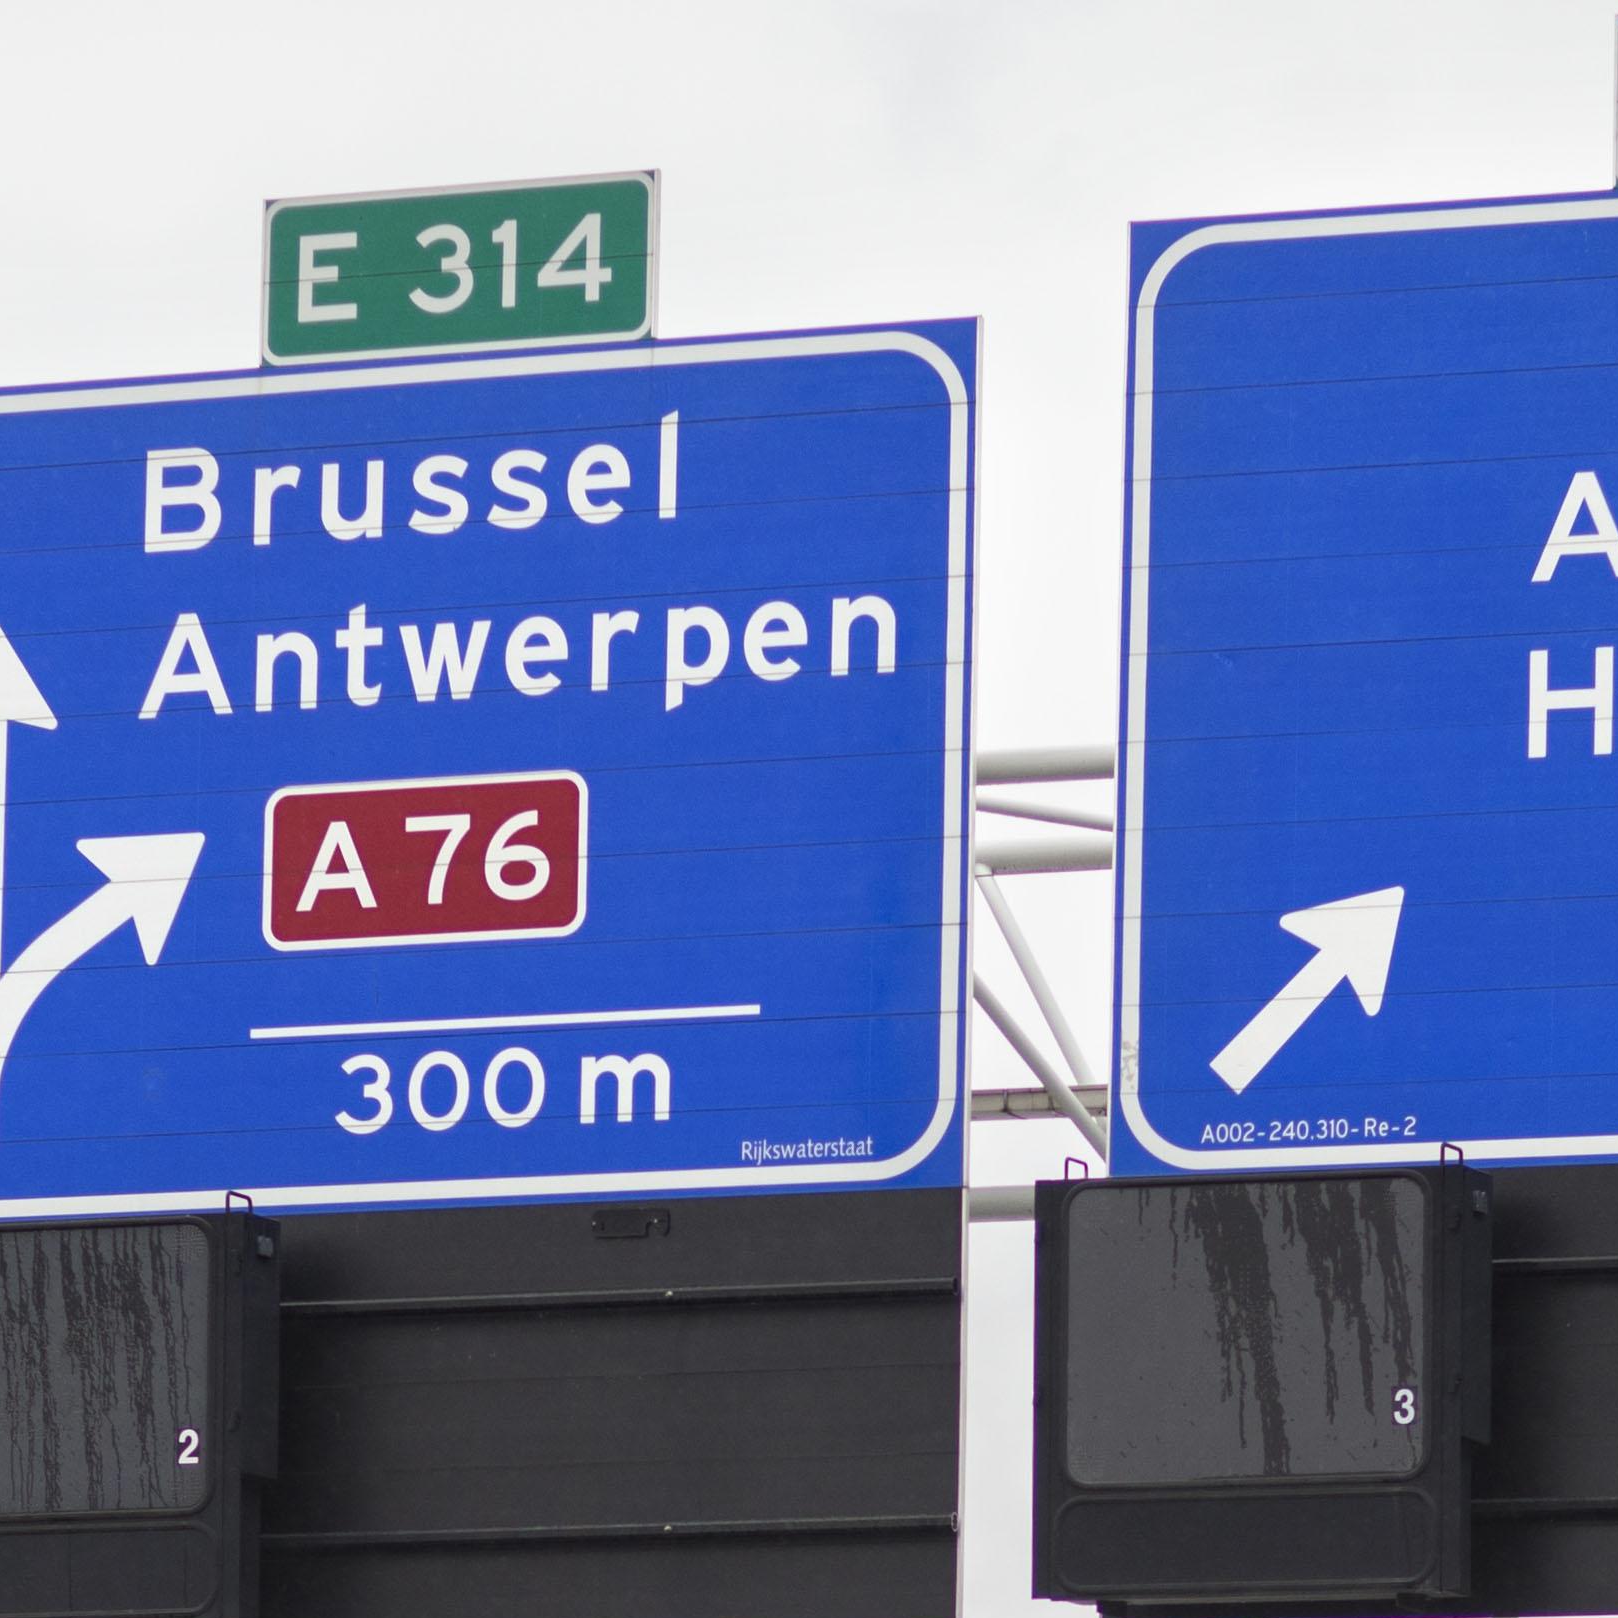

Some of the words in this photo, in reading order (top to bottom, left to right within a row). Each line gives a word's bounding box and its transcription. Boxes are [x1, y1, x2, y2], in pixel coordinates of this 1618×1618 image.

[296, 231, 358, 323] E
[409, 212, 612, 314] 314
[144, 410, 679, 553] Brussel
[138, 595, 897, 720] Antwerpen
[334, 1046, 546, 1135] 300
[579, 1053, 671, 1124] m
[740, 1135, 874, 1166] Rijkswaterstaat
[178, 1428, 199, 1465] 2
[1394, 1388, 1415, 1425] 3
